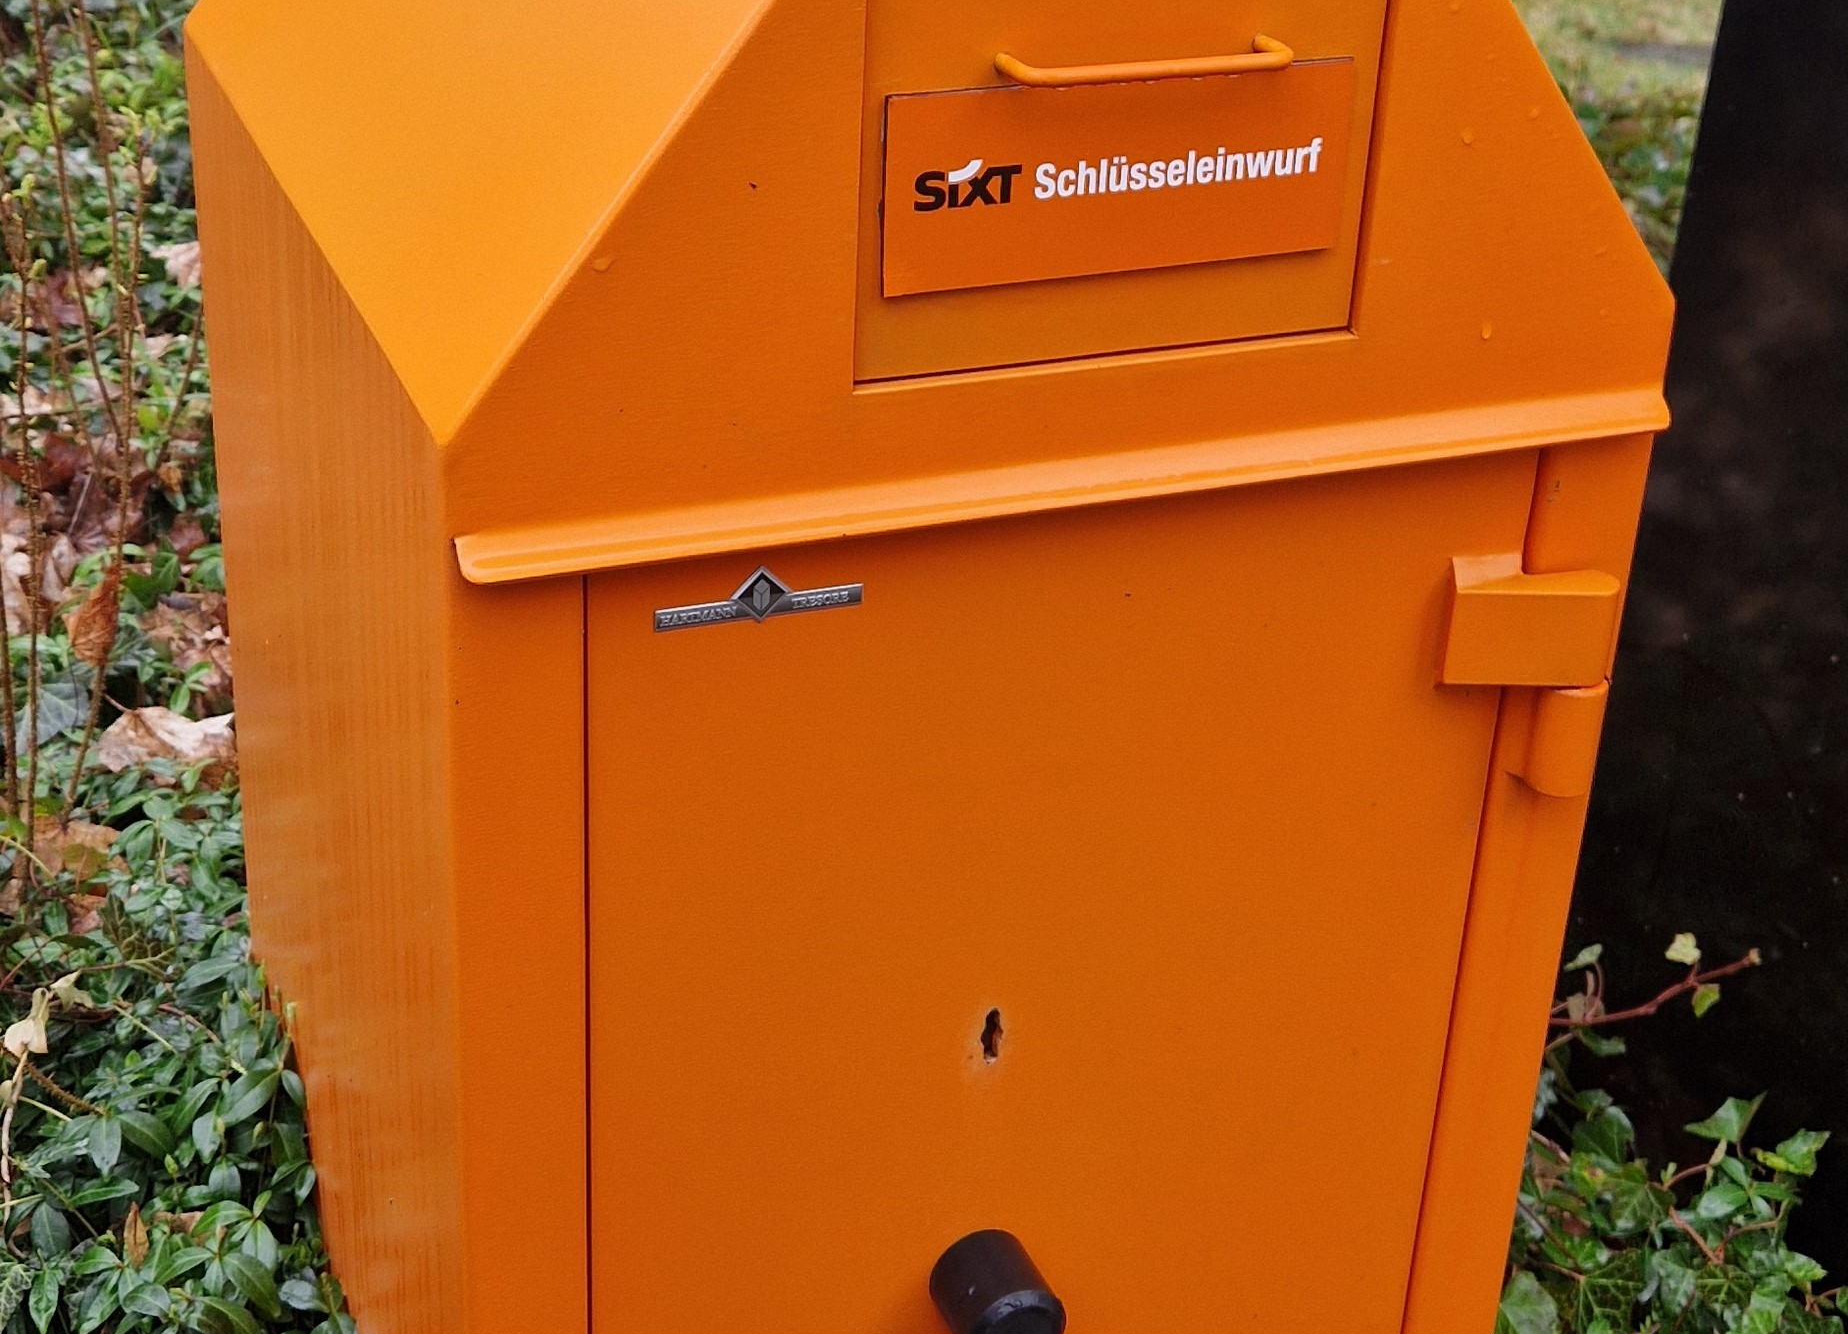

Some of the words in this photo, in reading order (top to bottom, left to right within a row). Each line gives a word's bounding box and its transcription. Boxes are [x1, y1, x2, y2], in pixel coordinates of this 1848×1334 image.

[913, 158, 1023, 213] SIXT
[1033, 136, 1324, 202] Schlüsseleinwurf
[659, 605, 738, 627] HARTMANN
[791, 590, 850, 609] TRESORE
